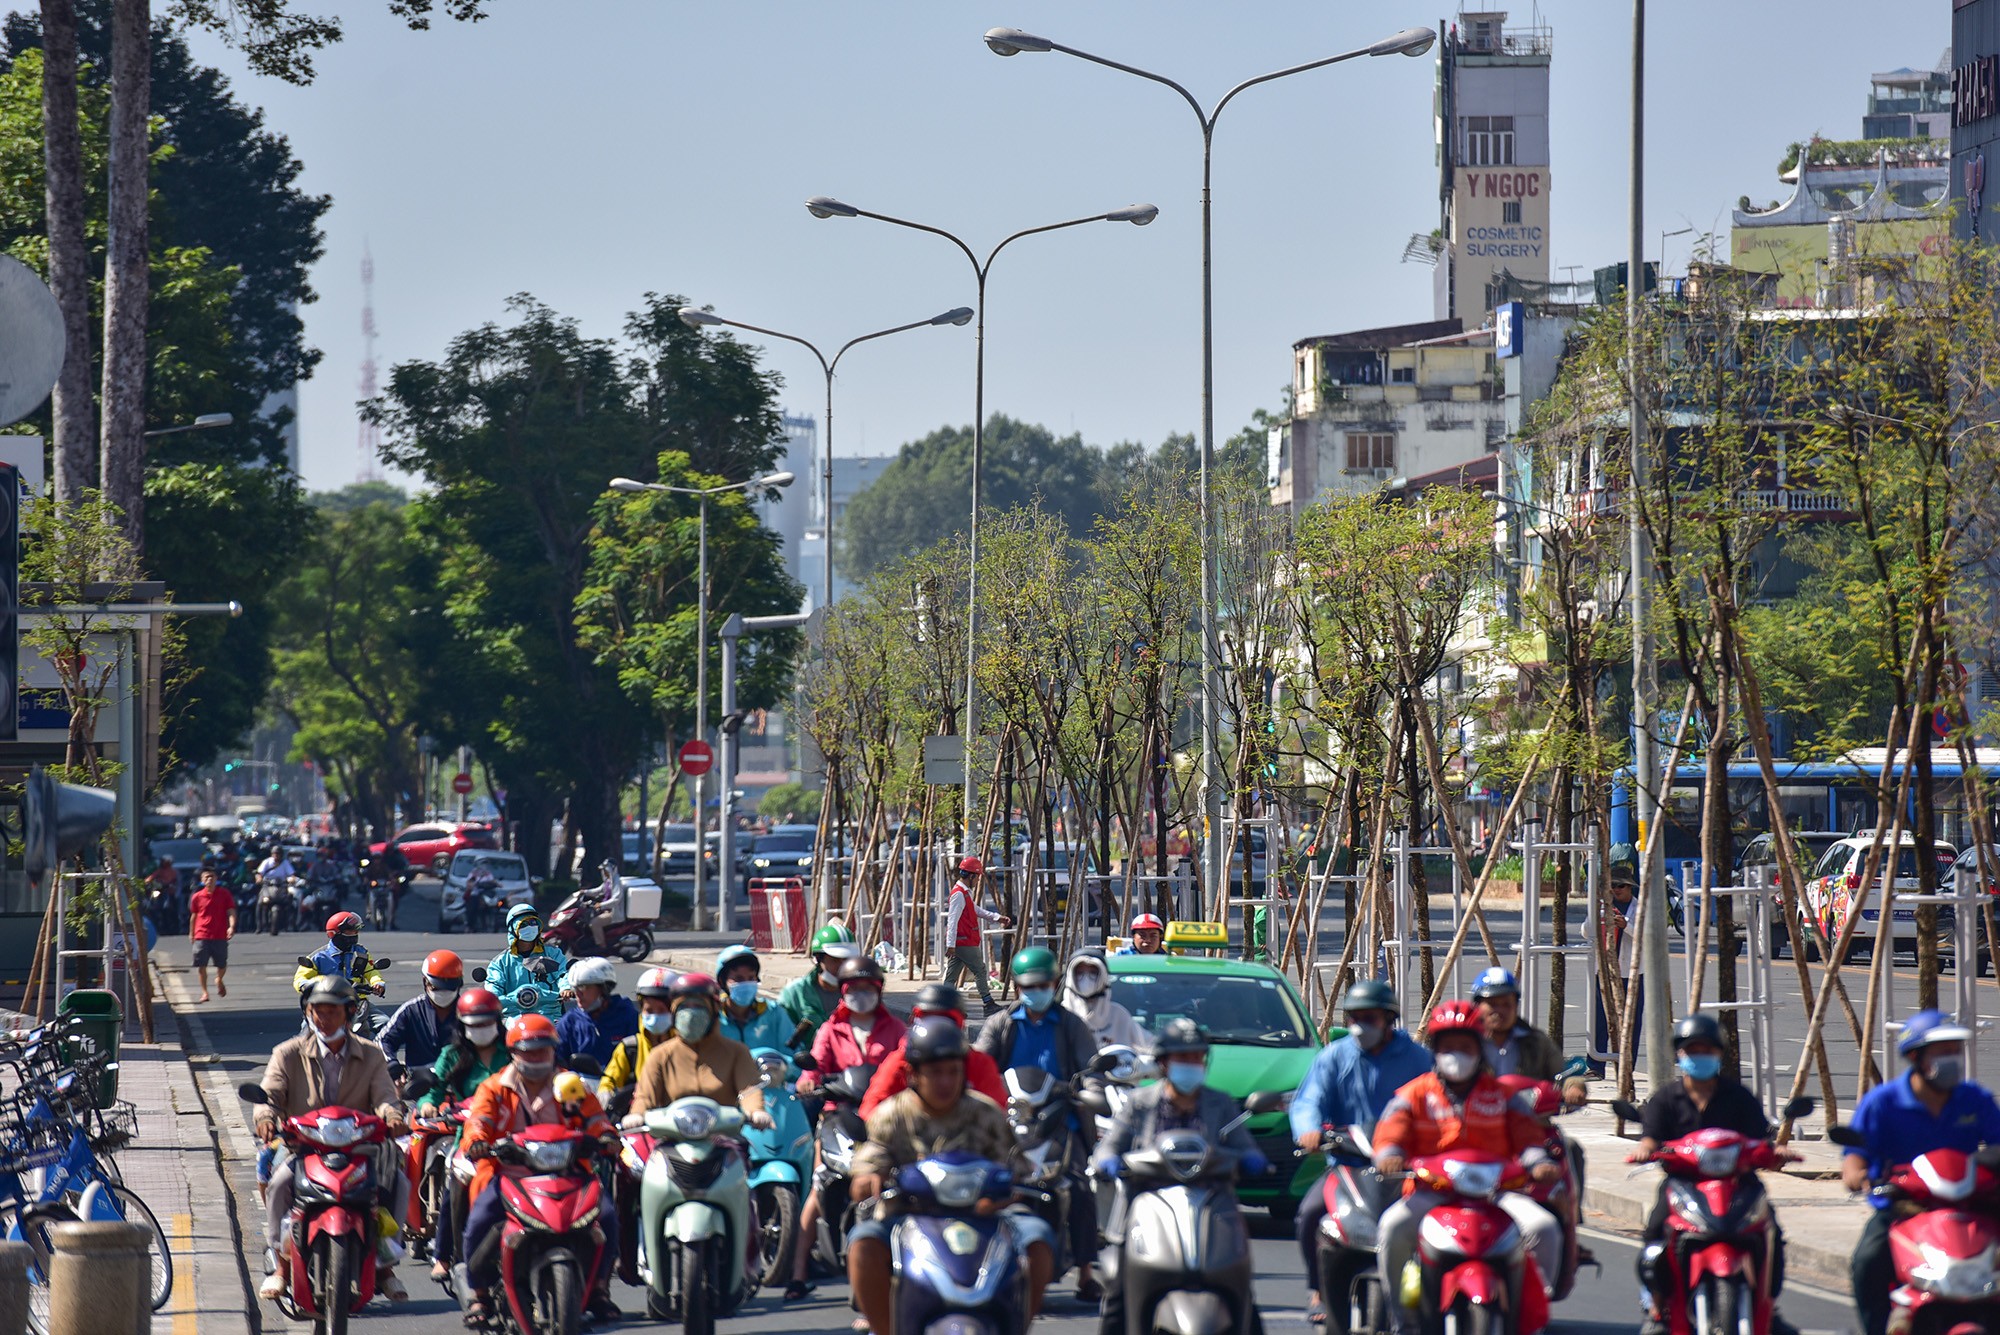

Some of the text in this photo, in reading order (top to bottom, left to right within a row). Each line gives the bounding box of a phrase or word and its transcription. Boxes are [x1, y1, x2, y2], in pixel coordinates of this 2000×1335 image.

[1467, 174, 1480, 197] Y
[1467, 227, 1541, 240] COSMETIC
[1467, 244, 1541, 257] SURGERY
[1175, 924, 1216, 934] TAXI
